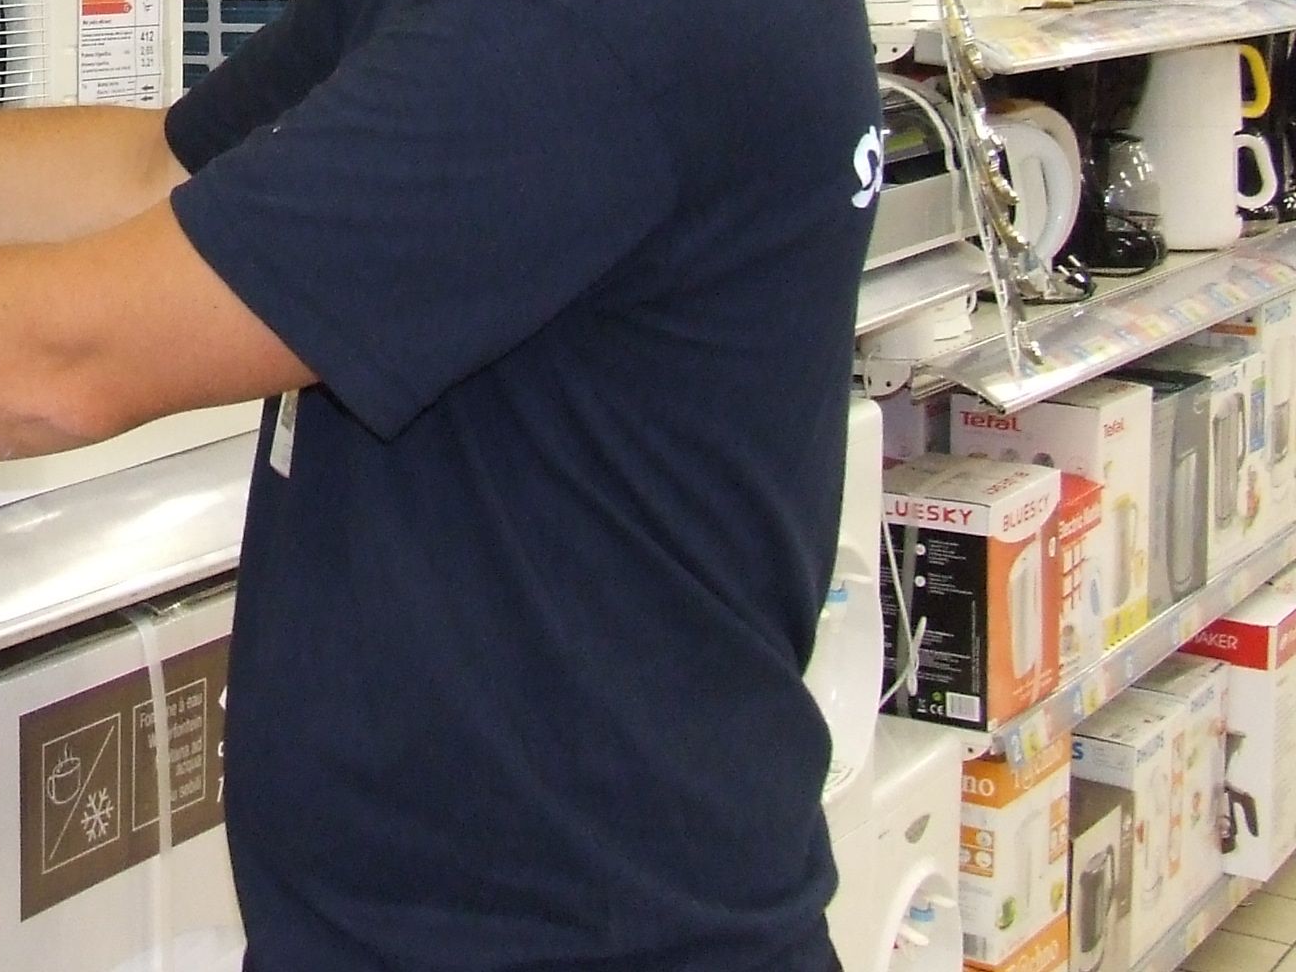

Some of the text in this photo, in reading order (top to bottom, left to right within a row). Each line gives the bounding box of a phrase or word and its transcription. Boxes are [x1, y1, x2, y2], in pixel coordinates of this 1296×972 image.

[960, 411, 1022, 432] Tefal
[1104, 417, 1125, 438] Tefal
[885, 500, 973, 527] LUESKY
[1003, 493, 1050, 533] BLUESKY
